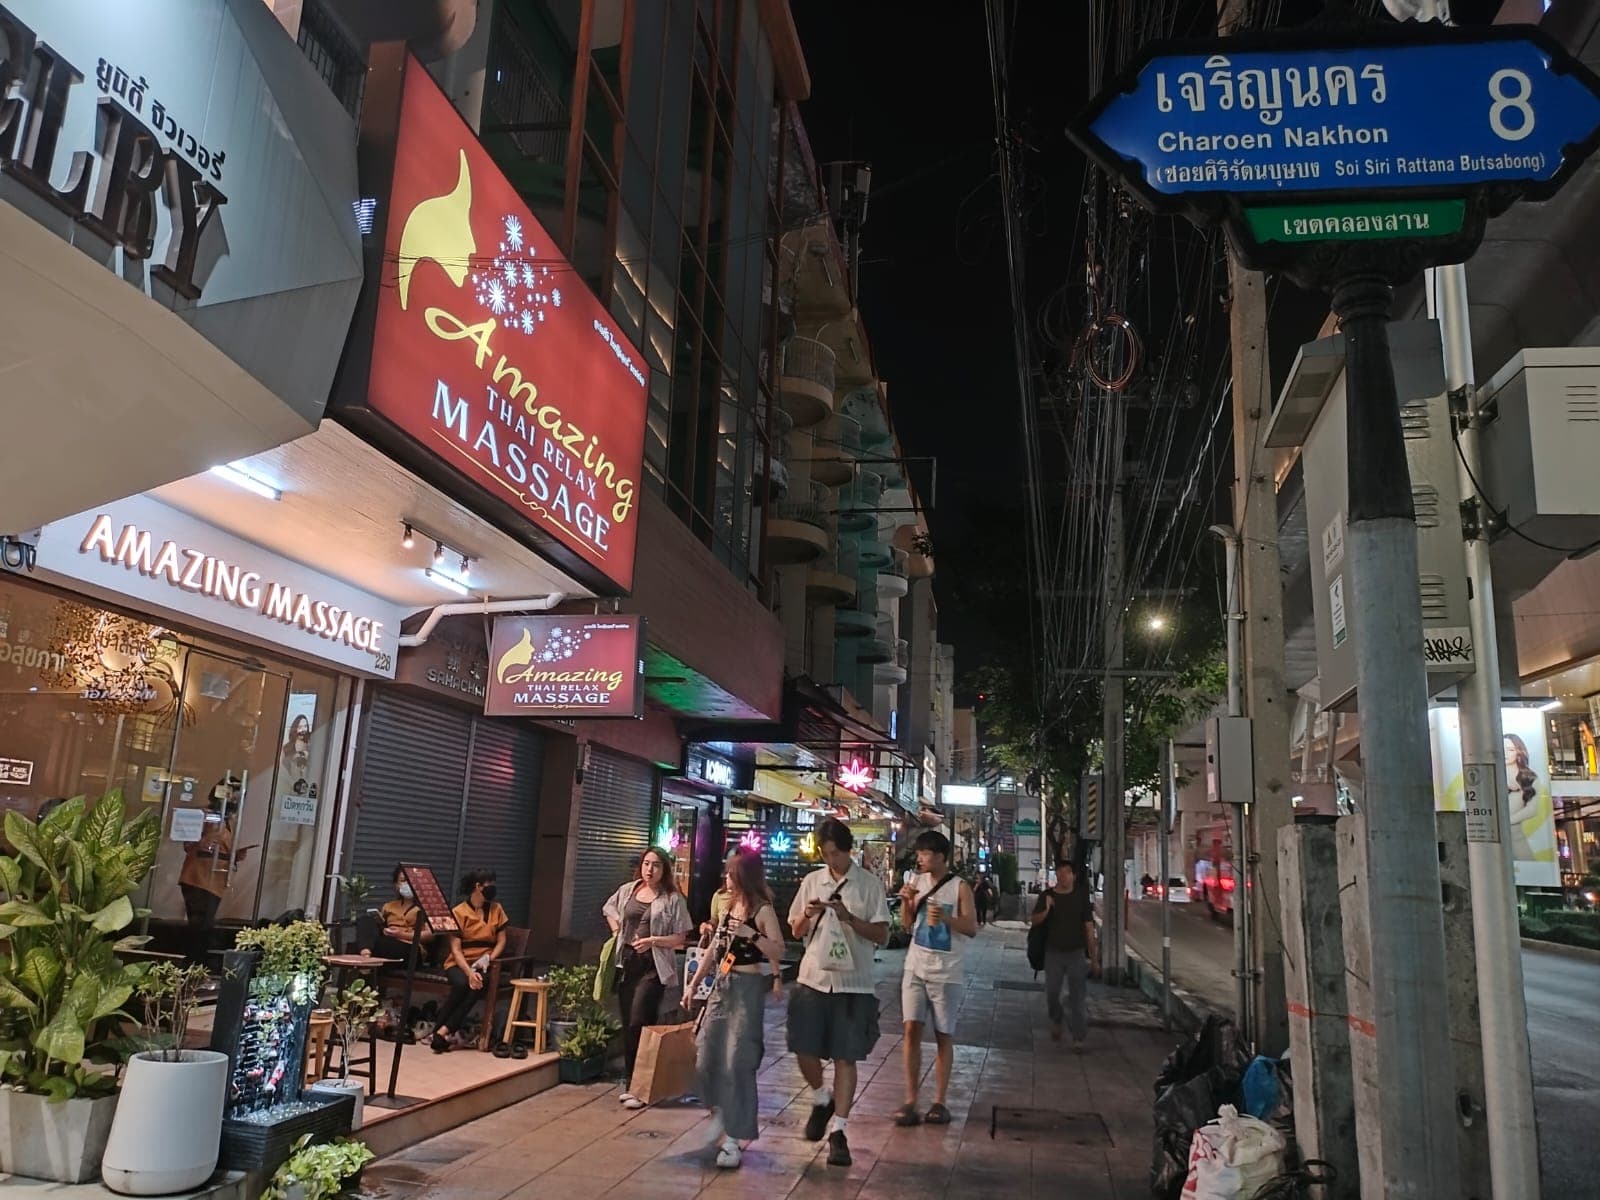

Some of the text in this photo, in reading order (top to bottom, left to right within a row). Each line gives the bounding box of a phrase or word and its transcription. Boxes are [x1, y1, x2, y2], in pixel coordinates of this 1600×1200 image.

[1155, 54, 1388, 126] เจริญนคร
[1487, 68, 1536, 141] 8
[1157, 124, 1389, 154] Charoen Nakhon
[1335, 159, 1361, 177] Soi
[1365, 157, 1391, 176] Siri
[1396, 156, 1456, 175] Rattana
[1460, 152, 1546, 172] Butsabong)
[1283, 211, 1430, 236] เขตคลองสาน
[424, 307, 634, 523] Amazing
[486, 384, 598, 501] THAI RELAX
[431, 378, 611, 552] MASSAGE
[79, 513, 384, 653] AMAZING MASSAGE
[374, 654, 391, 672] 228
[506, 664, 624, 691] Amazing
[513, 692, 611, 704] MASSAGE
[527, 684, 599, 692] THAI RELAX
